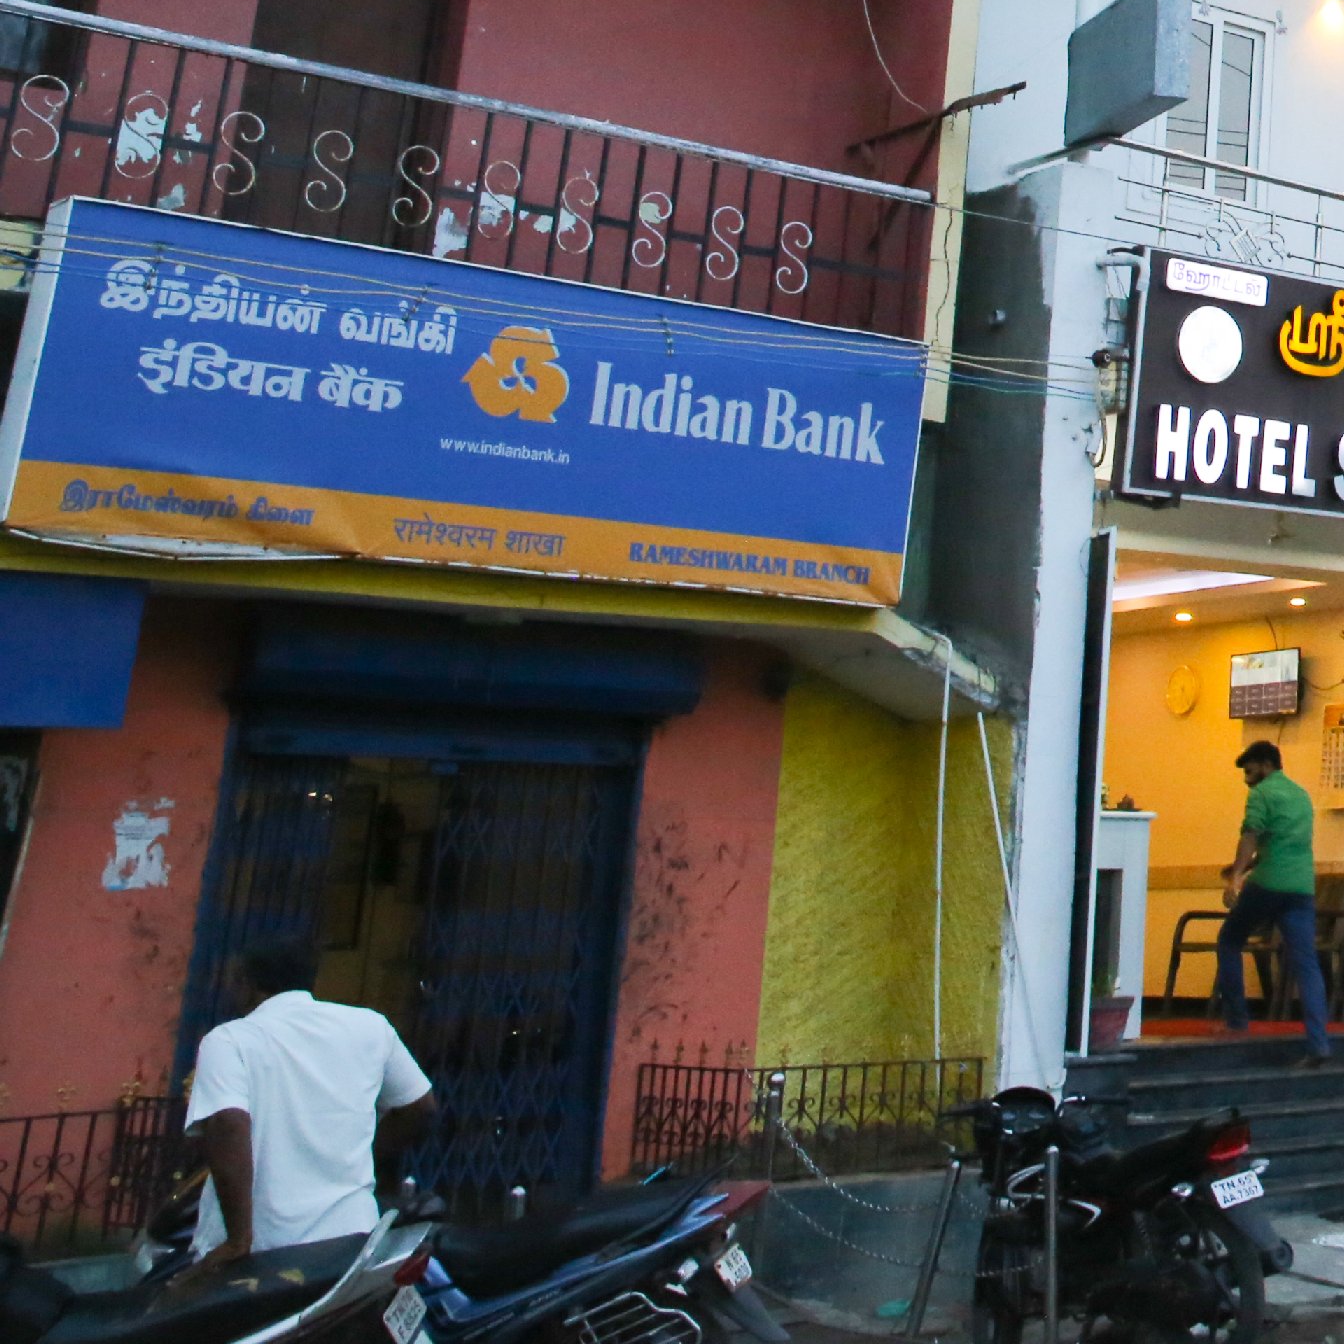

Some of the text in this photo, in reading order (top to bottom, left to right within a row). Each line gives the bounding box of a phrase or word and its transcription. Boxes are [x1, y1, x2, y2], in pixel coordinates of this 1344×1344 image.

[100, 258, 458, 355] இந்தியன் வங்கி
[137, 338, 405, 412] इंडियन बैंक
[589, 360, 885, 466] Indian Bank
[439, 436, 571, 465] www.indianbank.in
[1154, 402, 1316, 499] HOTEL
[393, 512, 566, 558] रामेश्वरम शाखा
[628, 542, 872, 586] RAMESHWARAM BRANCH
